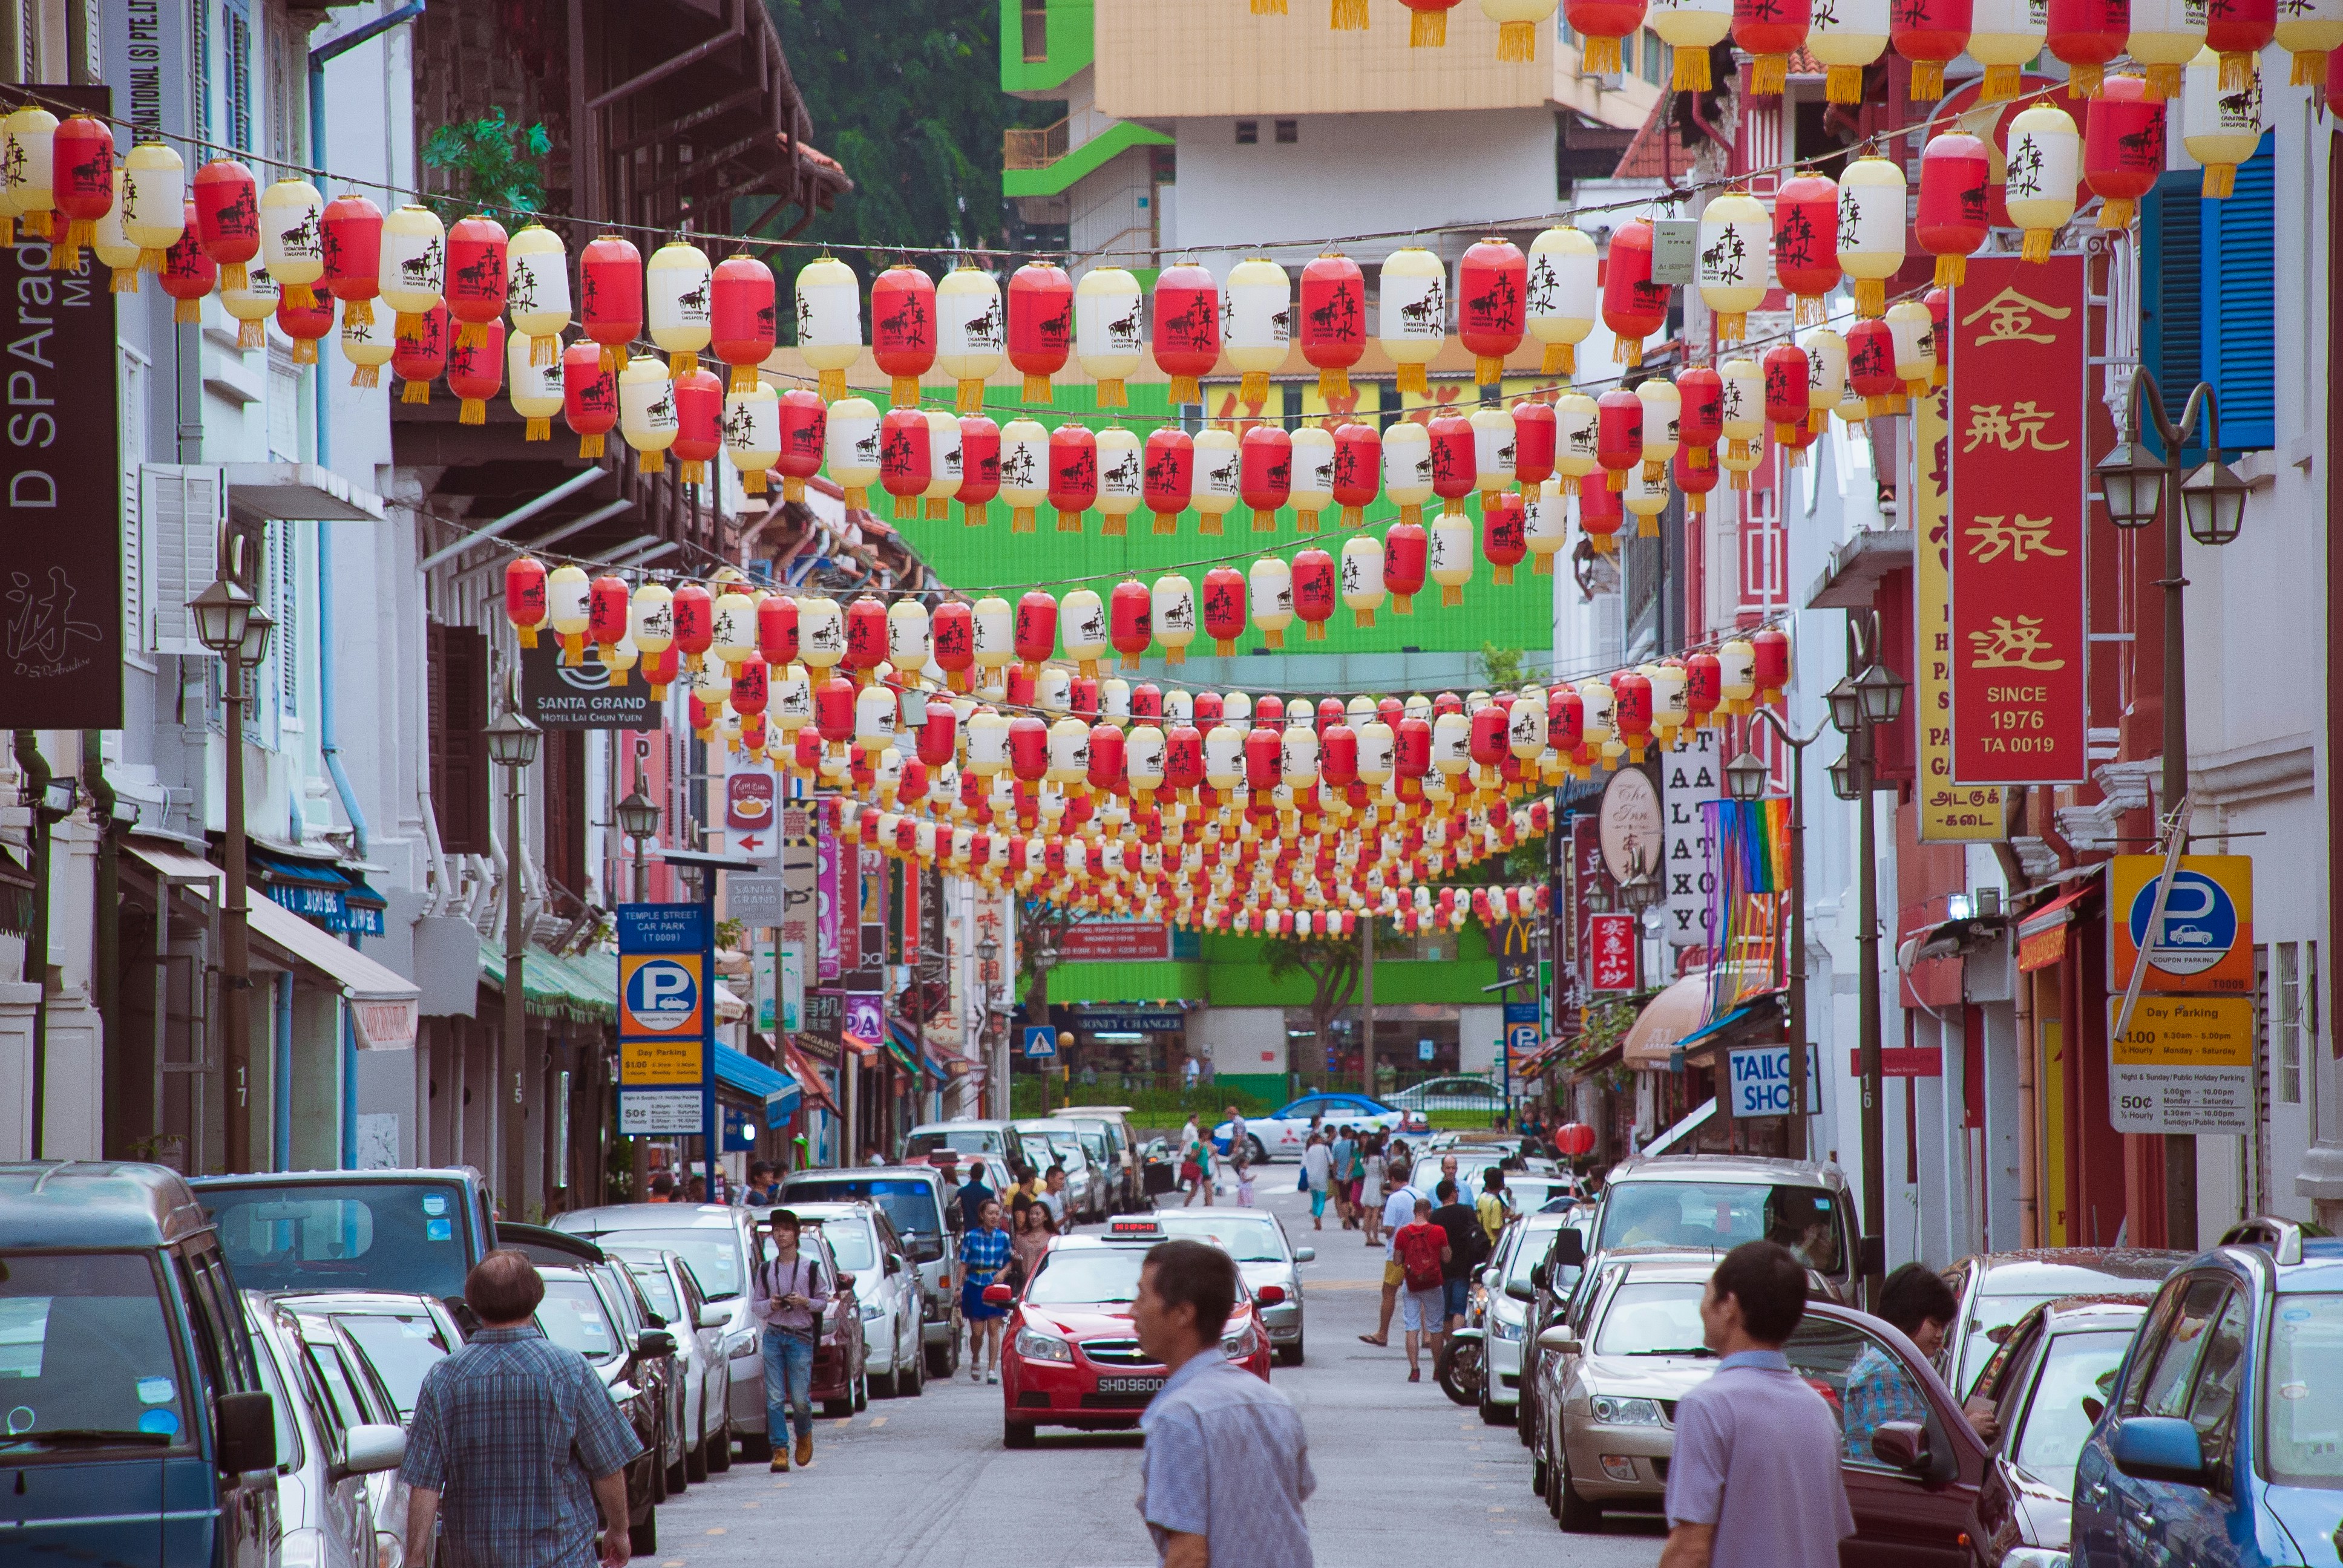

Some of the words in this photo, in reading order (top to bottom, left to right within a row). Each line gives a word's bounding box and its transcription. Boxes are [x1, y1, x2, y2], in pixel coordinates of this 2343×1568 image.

[128, 0, 158, 40] PTE.LT
[127, 44, 159, 61] (S)
[129, 67, 161, 147] ERNATIONAL
[2020, 133, 2044, 198] 牛车水
[1721, 222, 1746, 286] 牛车水
[515, 258, 537, 313] 牛车水
[1535, 253, 1559, 315] 牛车水
[7, 215, 56, 448] SPArad
[736, 402, 756, 449] 牛车水
[1014, 442, 1035, 488] 牛车水
[10, 469, 56, 508] D
[1987, 686, 2048, 702] SINCE
[537, 697, 587, 710] SANTA
[590, 697, 646, 710] GRAND
[1990, 710, 2045, 730] 1976
[1980, 737, 2007, 753] TA
[2010, 737, 2054, 753] 0019
[1619, 785, 1647, 802] The
[1612, 804, 1648, 822] Inn
[736, 885, 775, 894] SANTA
[732, 895, 777, 904] GRAND
[643, 967, 690, 1010] P
[2147, 1008, 2169, 1019] Day
[2174, 1008, 2219, 1019] Parking
[2125, 1031, 2155, 1044] 1.00
[2129, 1046, 2154, 1054] Hourly
[2163, 1047, 2193, 1055] Monday
[2121, 1073, 2138, 1082] Night
[2220, 1074, 2246, 1083] Parking
[1744, 1083, 1790, 1111] SHO
[2121, 1096, 2152, 1109] 50¢
[2202, 1097, 2234, 1106] Saturday
[2129, 1111, 2154, 1120] Hourly
[1099, 1378, 1167, 1393] SHD9600
